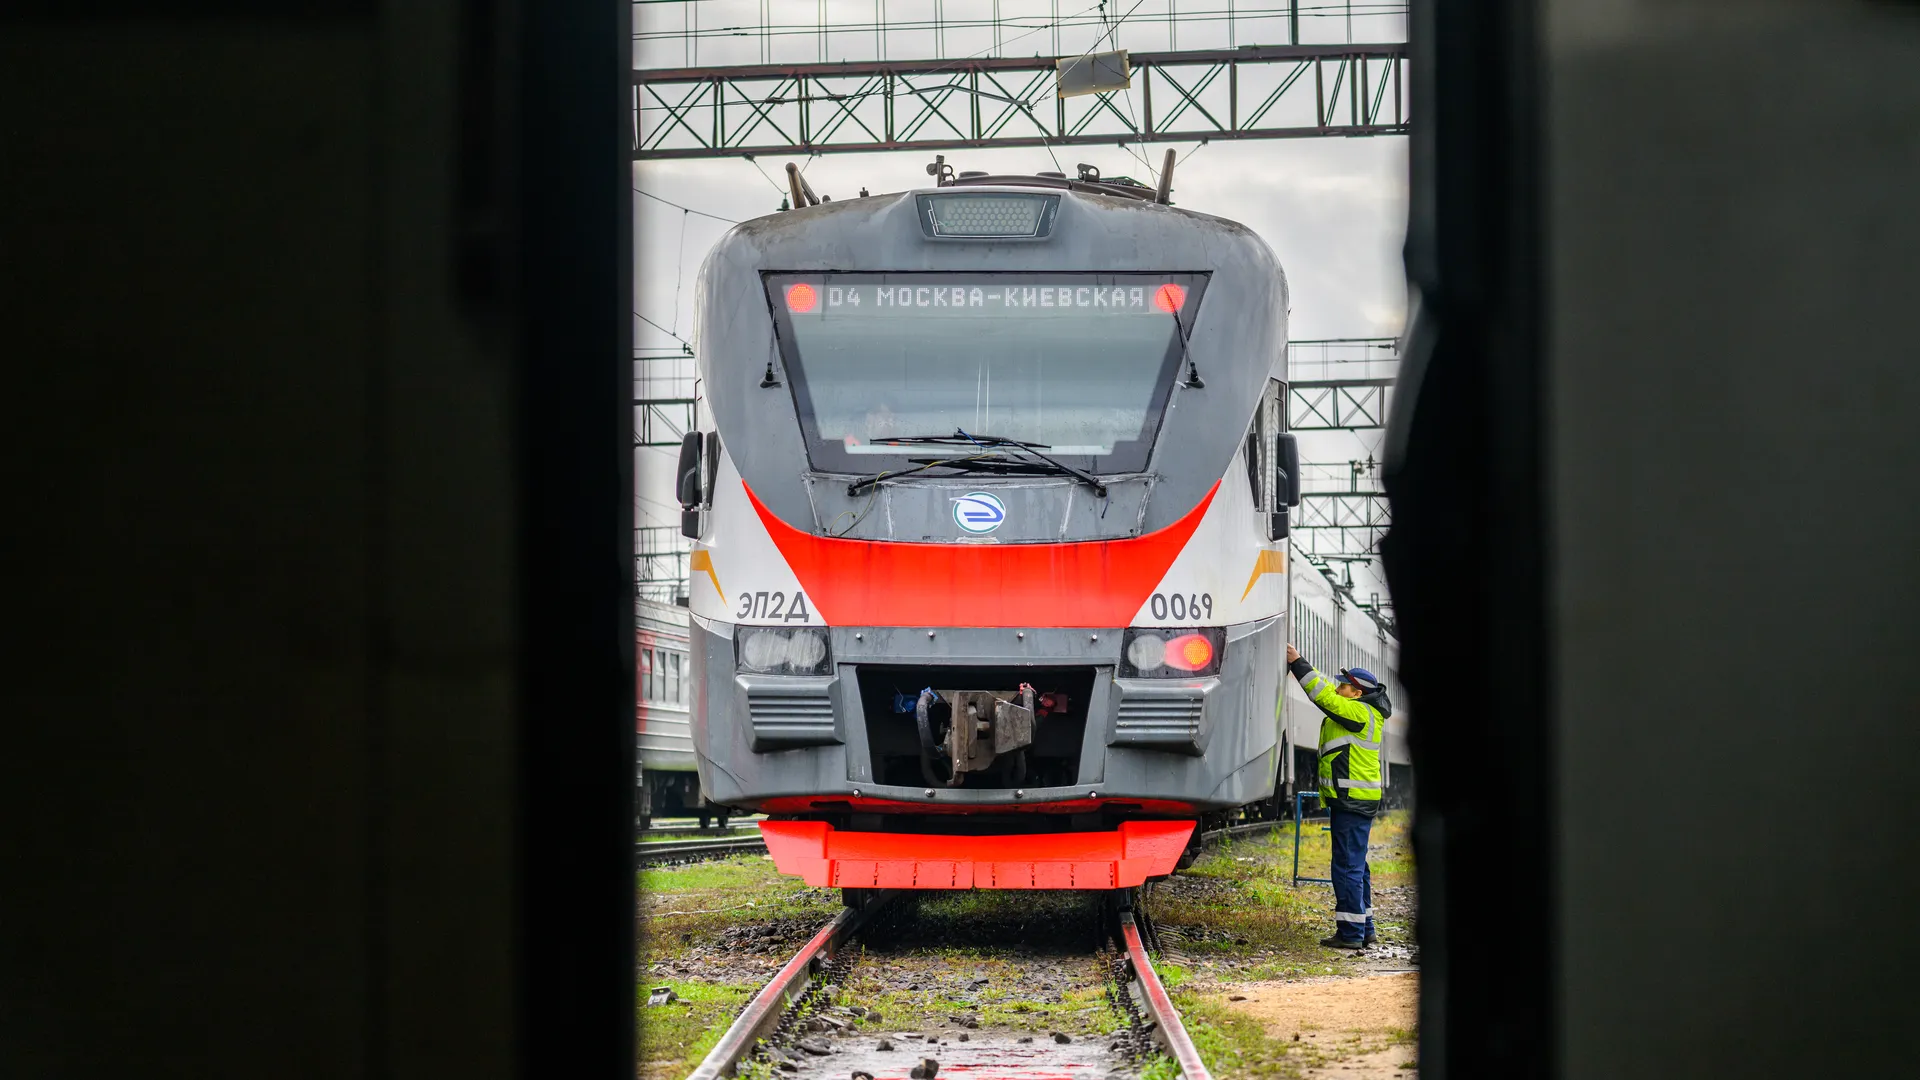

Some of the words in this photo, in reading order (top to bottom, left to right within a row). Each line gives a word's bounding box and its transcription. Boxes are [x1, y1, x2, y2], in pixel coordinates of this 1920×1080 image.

[829, 287, 861, 307] D4
[877, 287, 1144, 307] МОСКВА-КИЕВСКАЯ
[736, 591, 810, 623] ЭП2Д
[1150, 592, 1213, 621] 0069
